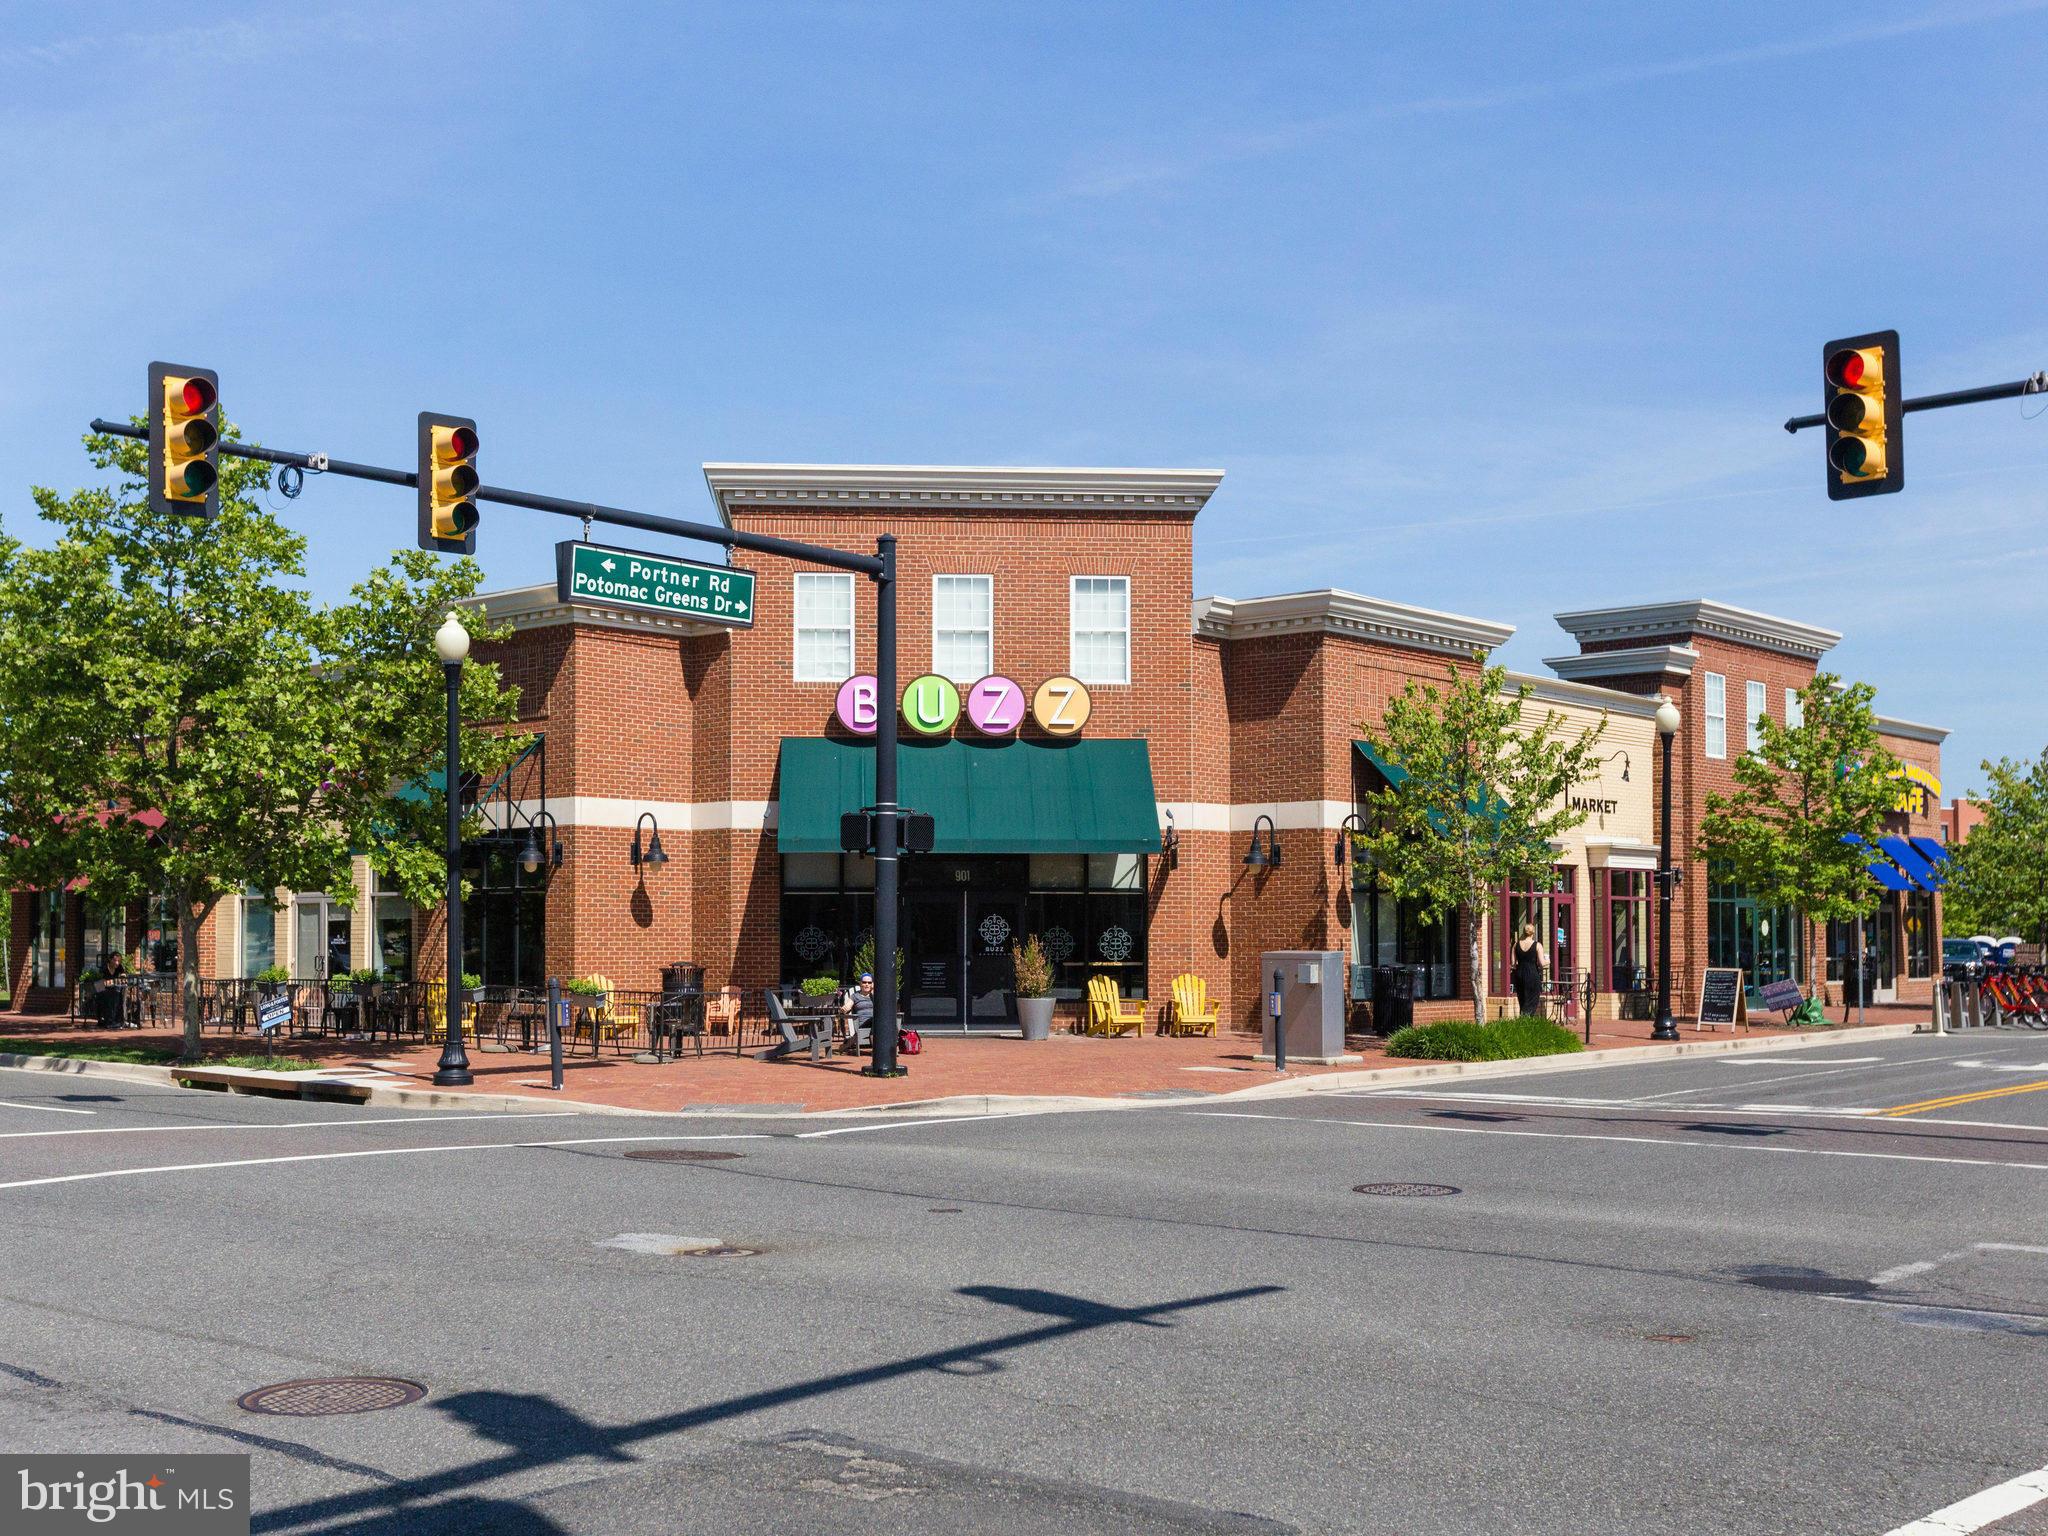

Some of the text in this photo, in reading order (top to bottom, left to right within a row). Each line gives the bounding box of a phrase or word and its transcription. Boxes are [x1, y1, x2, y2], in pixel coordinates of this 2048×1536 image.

[629, 561, 730, 593] Portner Rd
[575, 573, 732, 612] Potomac Greens Dr
[852, 684, 1078, 728] BUZZ
[1571, 797, 1618, 814] MARKET
[1893, 786, 1924, 814] AFE
[955, 870, 970, 881] 901
